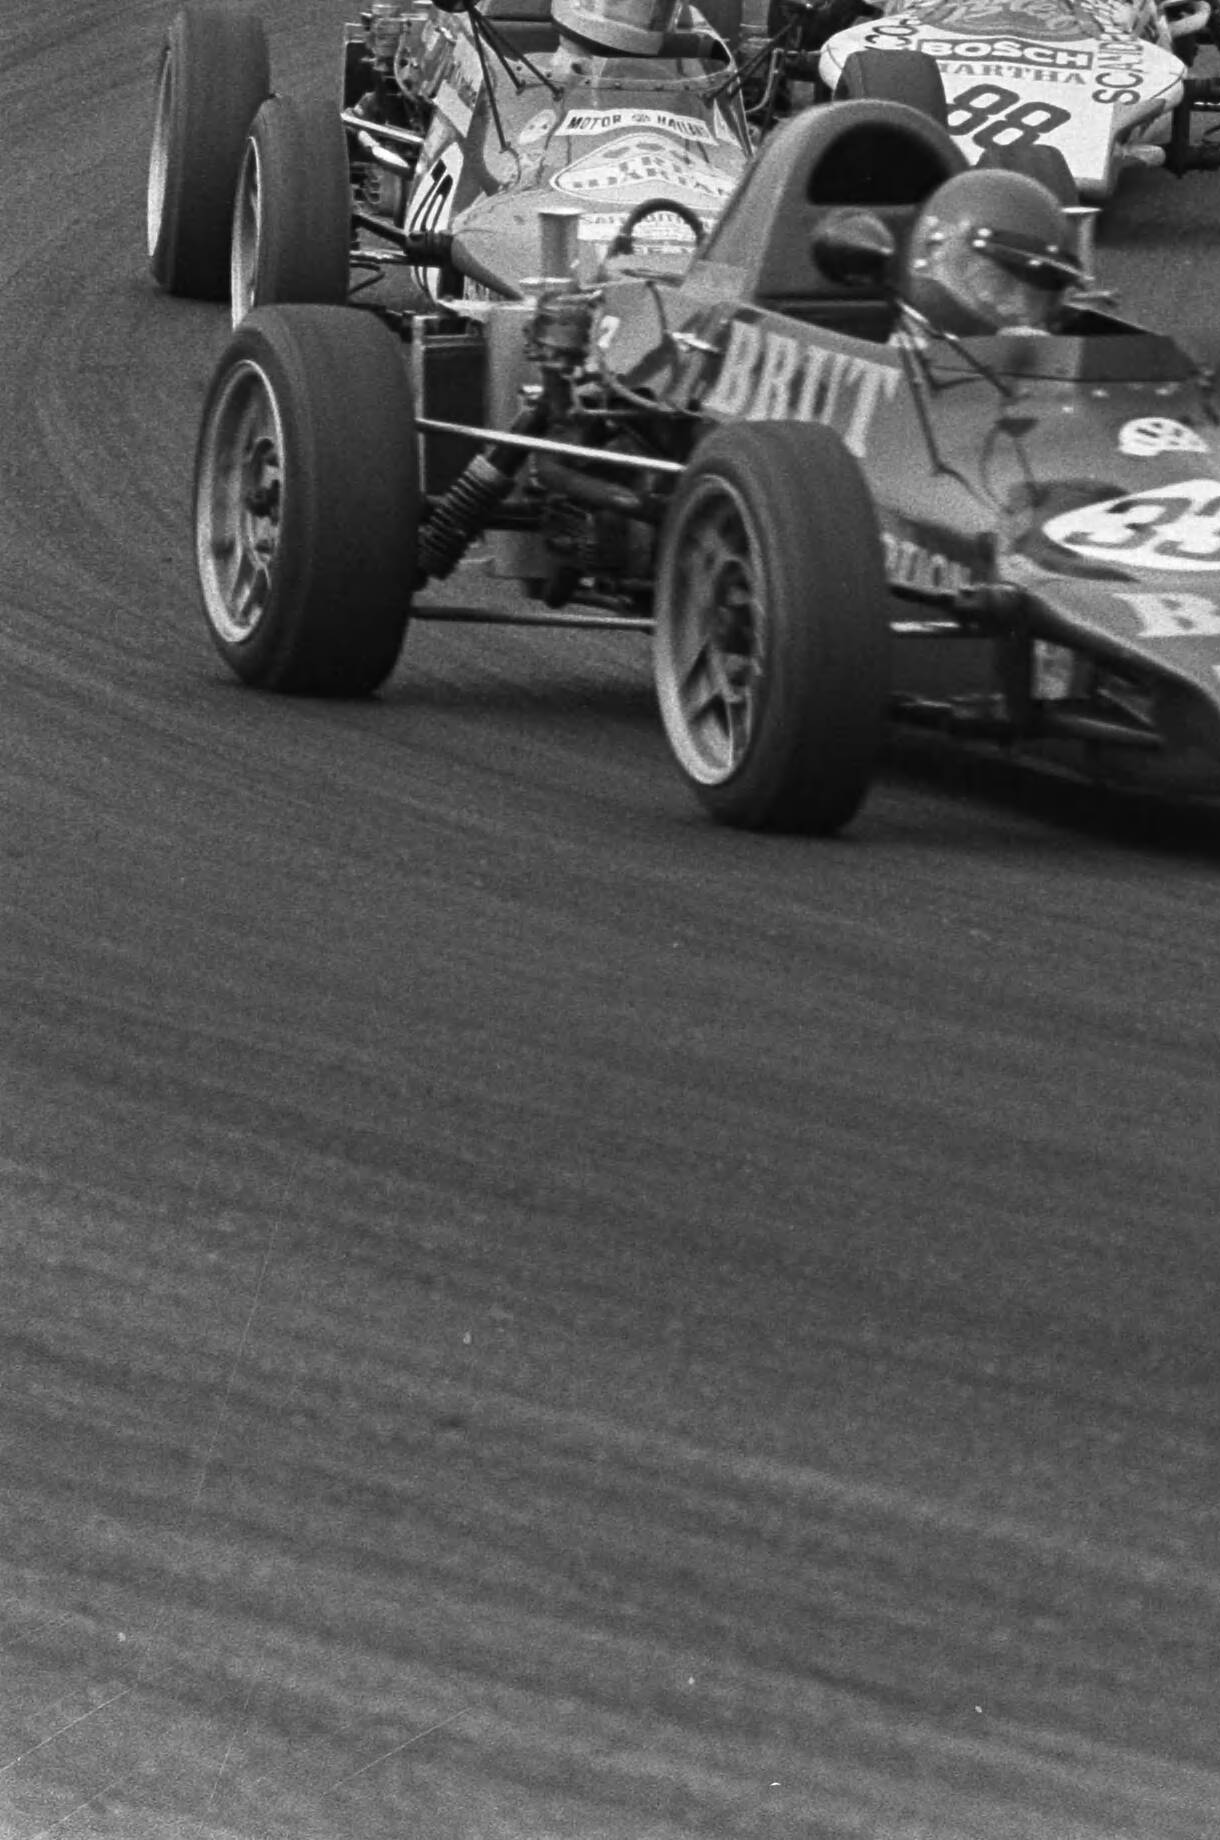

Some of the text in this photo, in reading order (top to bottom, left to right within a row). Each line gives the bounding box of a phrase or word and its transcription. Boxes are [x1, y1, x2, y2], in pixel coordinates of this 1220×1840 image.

[920, 40, 1090, 67] BOSCH
[567, 113, 622, 130] MOTOR
[701, 319, 902, 459] BRUT
